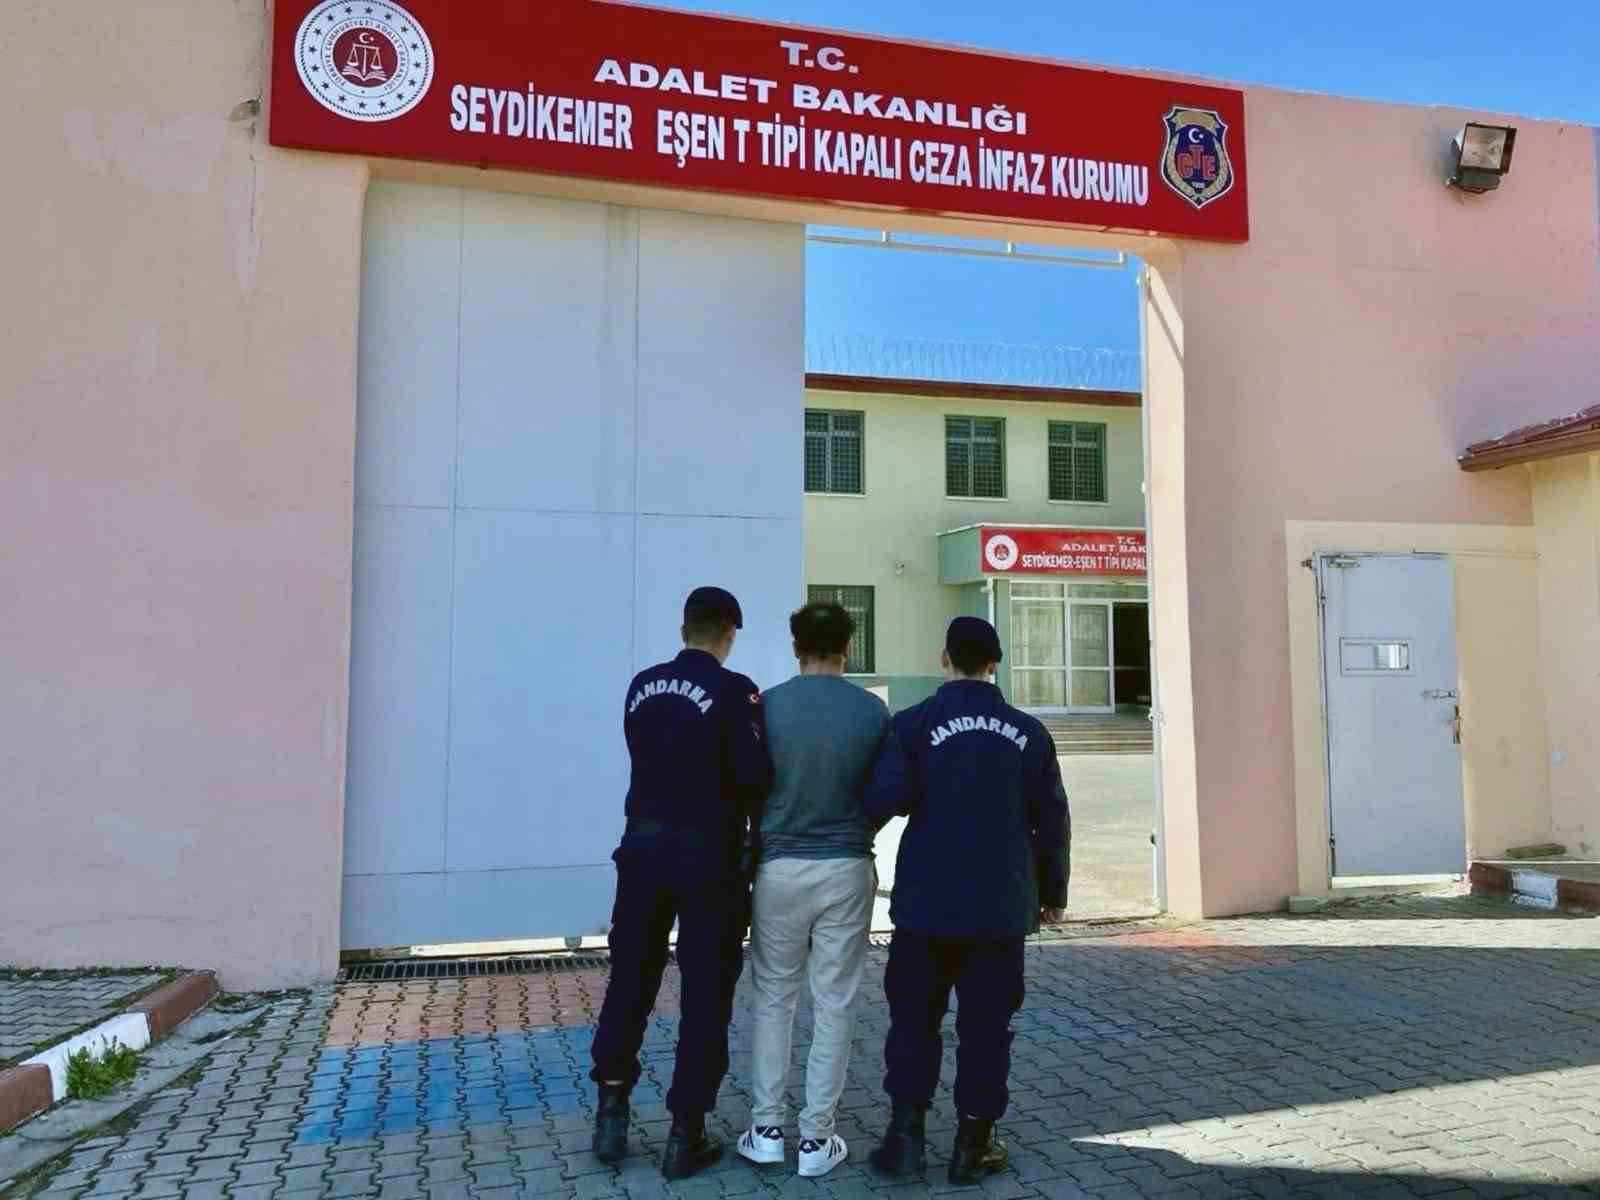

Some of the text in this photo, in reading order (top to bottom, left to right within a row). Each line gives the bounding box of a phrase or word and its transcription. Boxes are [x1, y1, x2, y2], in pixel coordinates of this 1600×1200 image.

[780, 40, 859, 74] T.C.
[593, 59, 1027, 135] ADALET BAKANLIĞI
[450, 81, 1149, 206] SEYDİKEMER EŞEN T TİPİ KAPALI CEZA İNFAZ KURUMU
[1061, 543, 1117, 553] ADALET
[1116, 535, 1140, 545] T.C.
[1097, 556, 1103, 568] T
[1104, 552, 1120, 569] TİPİ
[629, 679, 713, 715] JANDARMA
[930, 715, 1028, 752] JANDARMA
